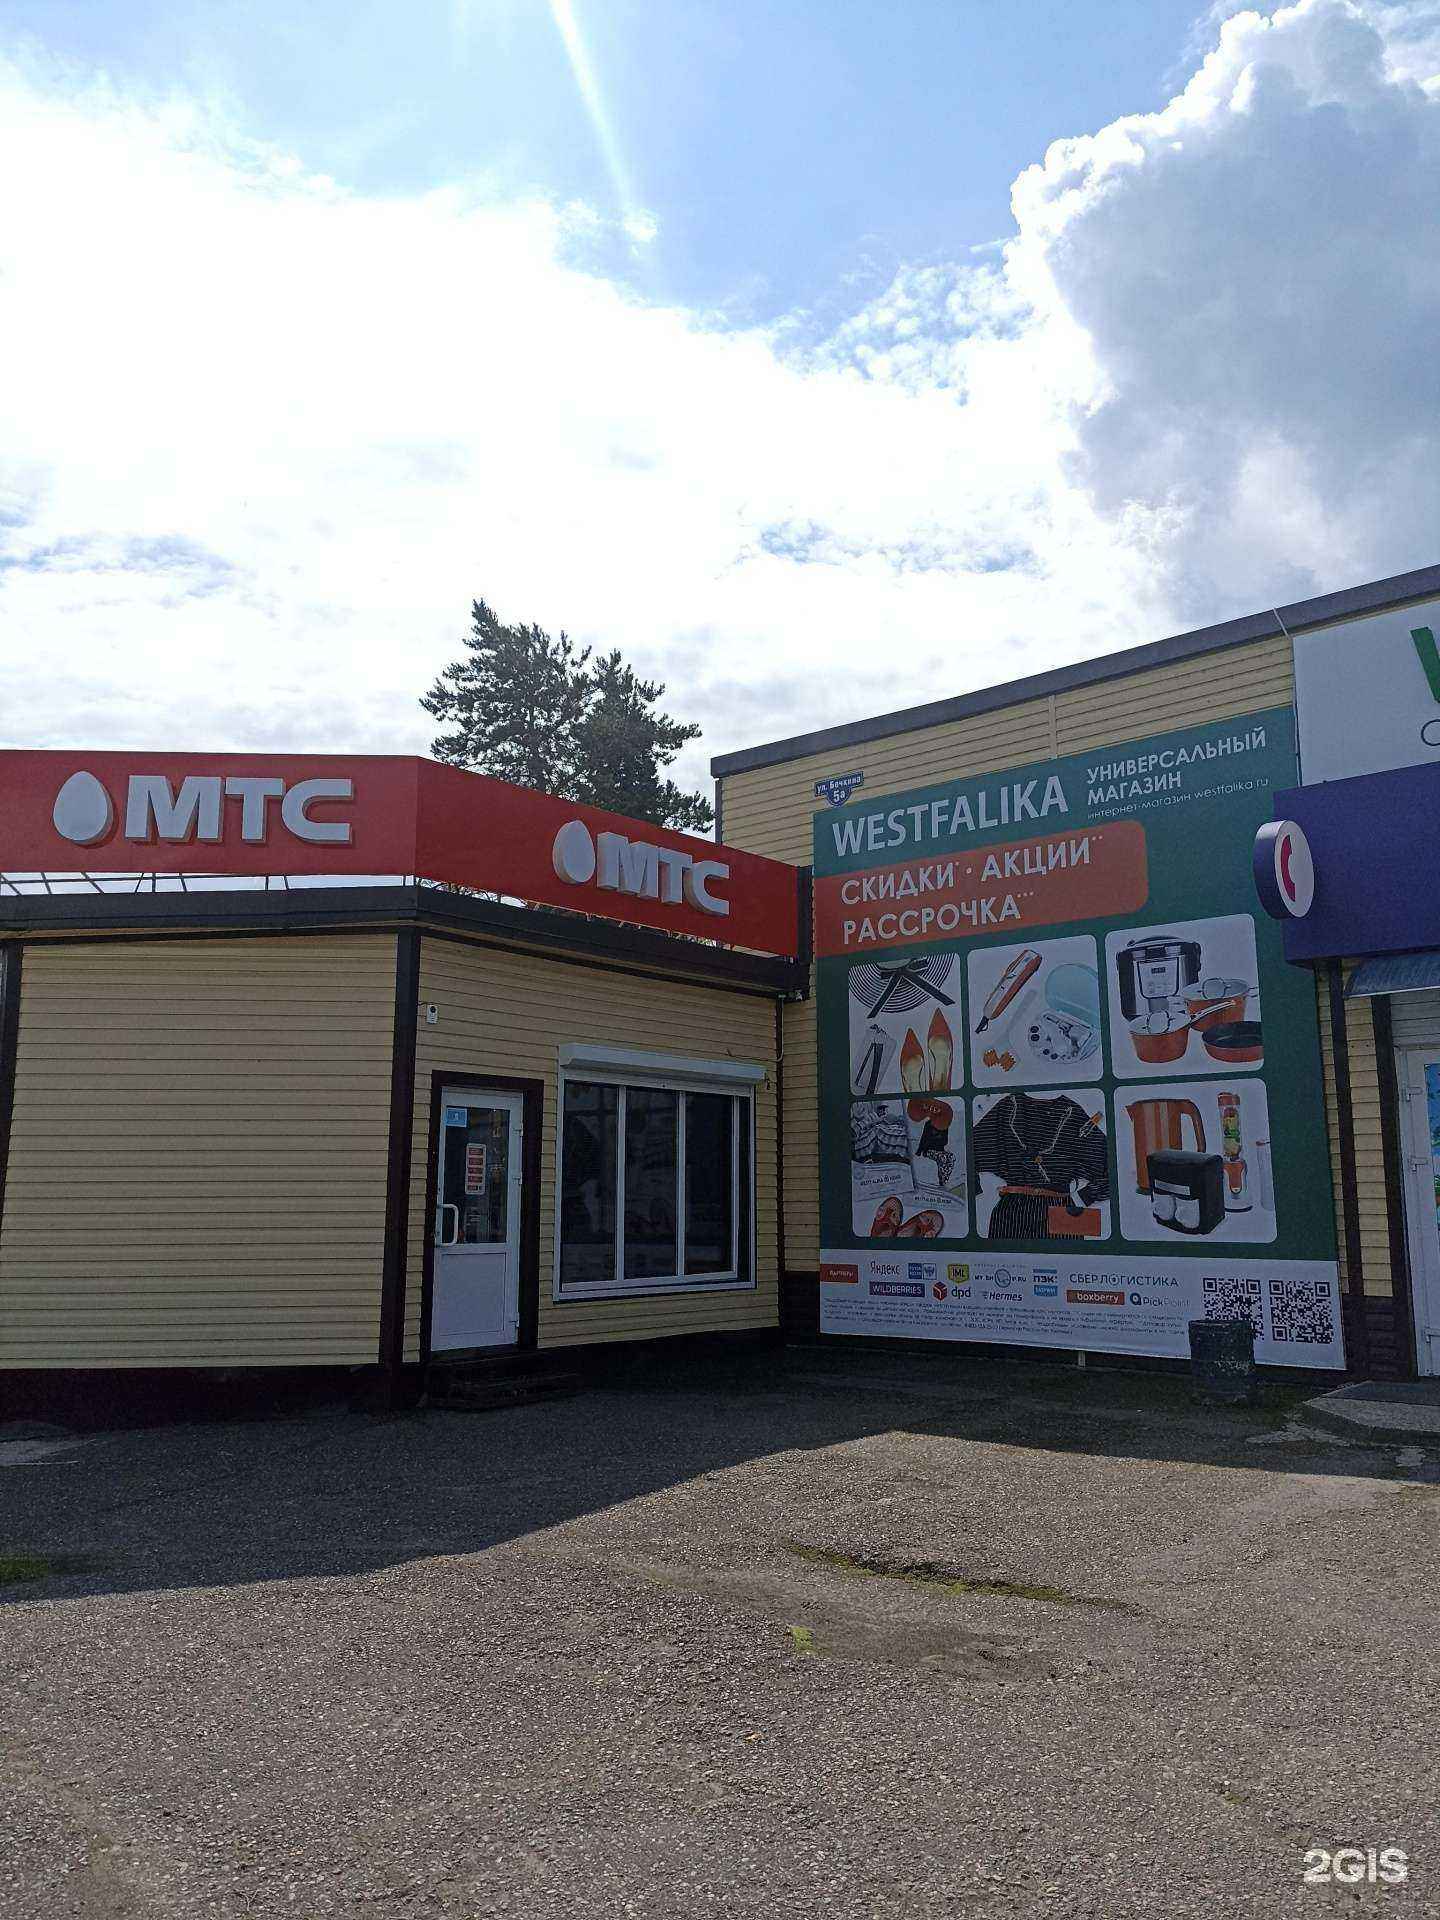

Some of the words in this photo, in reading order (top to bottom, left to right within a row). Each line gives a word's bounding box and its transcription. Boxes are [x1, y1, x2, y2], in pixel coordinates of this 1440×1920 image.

[1087, 726, 1267, 785] УНИВЕРСАЛЬНЫЙ
[816, 784, 828, 794] ул.
[1087, 771, 1182, 806] МАГАЗИН
[1087, 792, 1192, 819] интернет-магазин
[1193, 776, 1269, 800] westfalika.ru
[125, 775, 353, 842] МТС
[831, 775, 1069, 857] WESTFALIKA
[597, 831, 730, 916] МТС
[869, 1261, 901, 1277] Яндекс
[951, 1266, 966, 1278] IML
[872, 1284, 923, 1295] WILDBERRIES
[951, 1286, 972, 1300] dpd
[988, 1291, 1023, 1302] Hermes
[1076, 1293, 1120, 1303] boxberry
